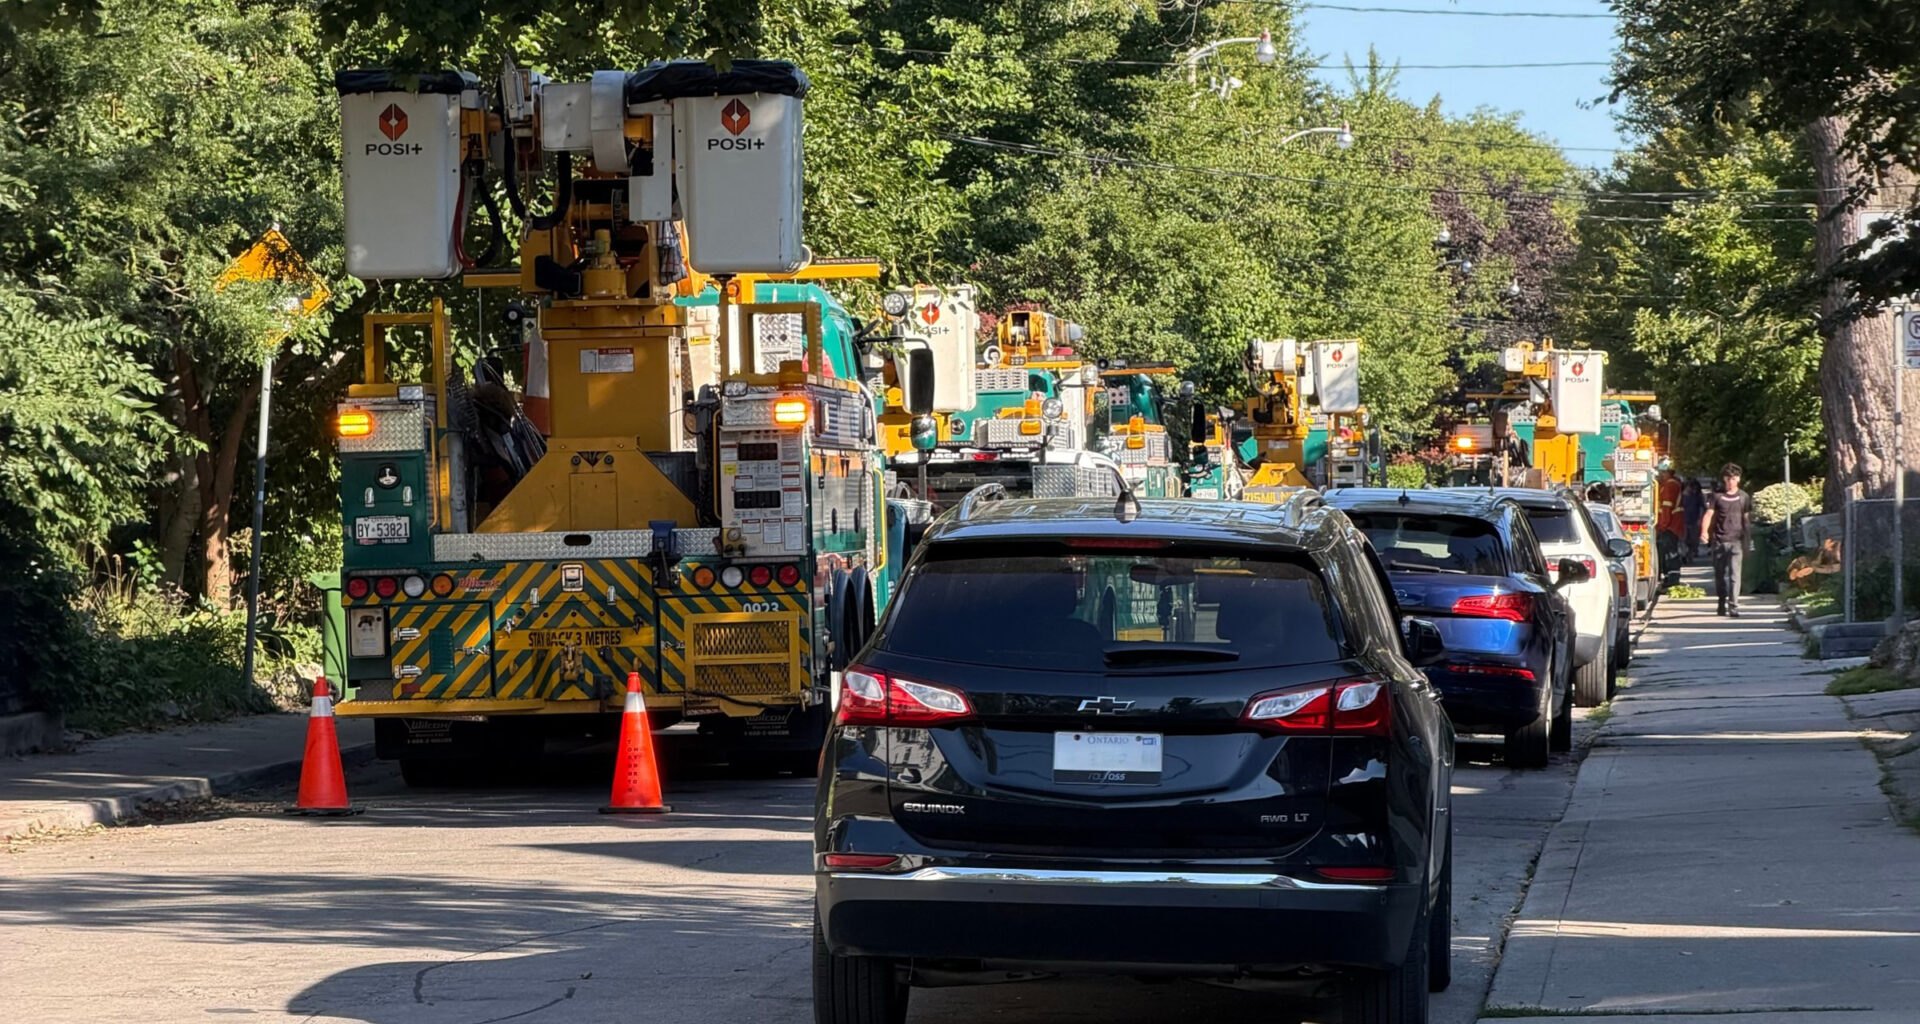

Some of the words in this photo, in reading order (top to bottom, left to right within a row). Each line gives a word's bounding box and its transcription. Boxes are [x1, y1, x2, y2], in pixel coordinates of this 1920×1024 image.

[365, 143, 423, 156] POSI+
[707, 138, 765, 151] POSI+
[357, 523, 370, 538] BY
[376, 522, 408, 537] 53821
[528, 631, 544, 647] STAY
[545, 631, 573, 646] BACK
[576, 632, 582, 646] 3
[585, 630, 621, 646] METRES
[1087, 735, 1129, 745] ONTARIO
[903, 802, 965, 815] EQUINOX
[1260, 814, 1289, 823] AWD
[1294, 813, 1310, 822] LT
